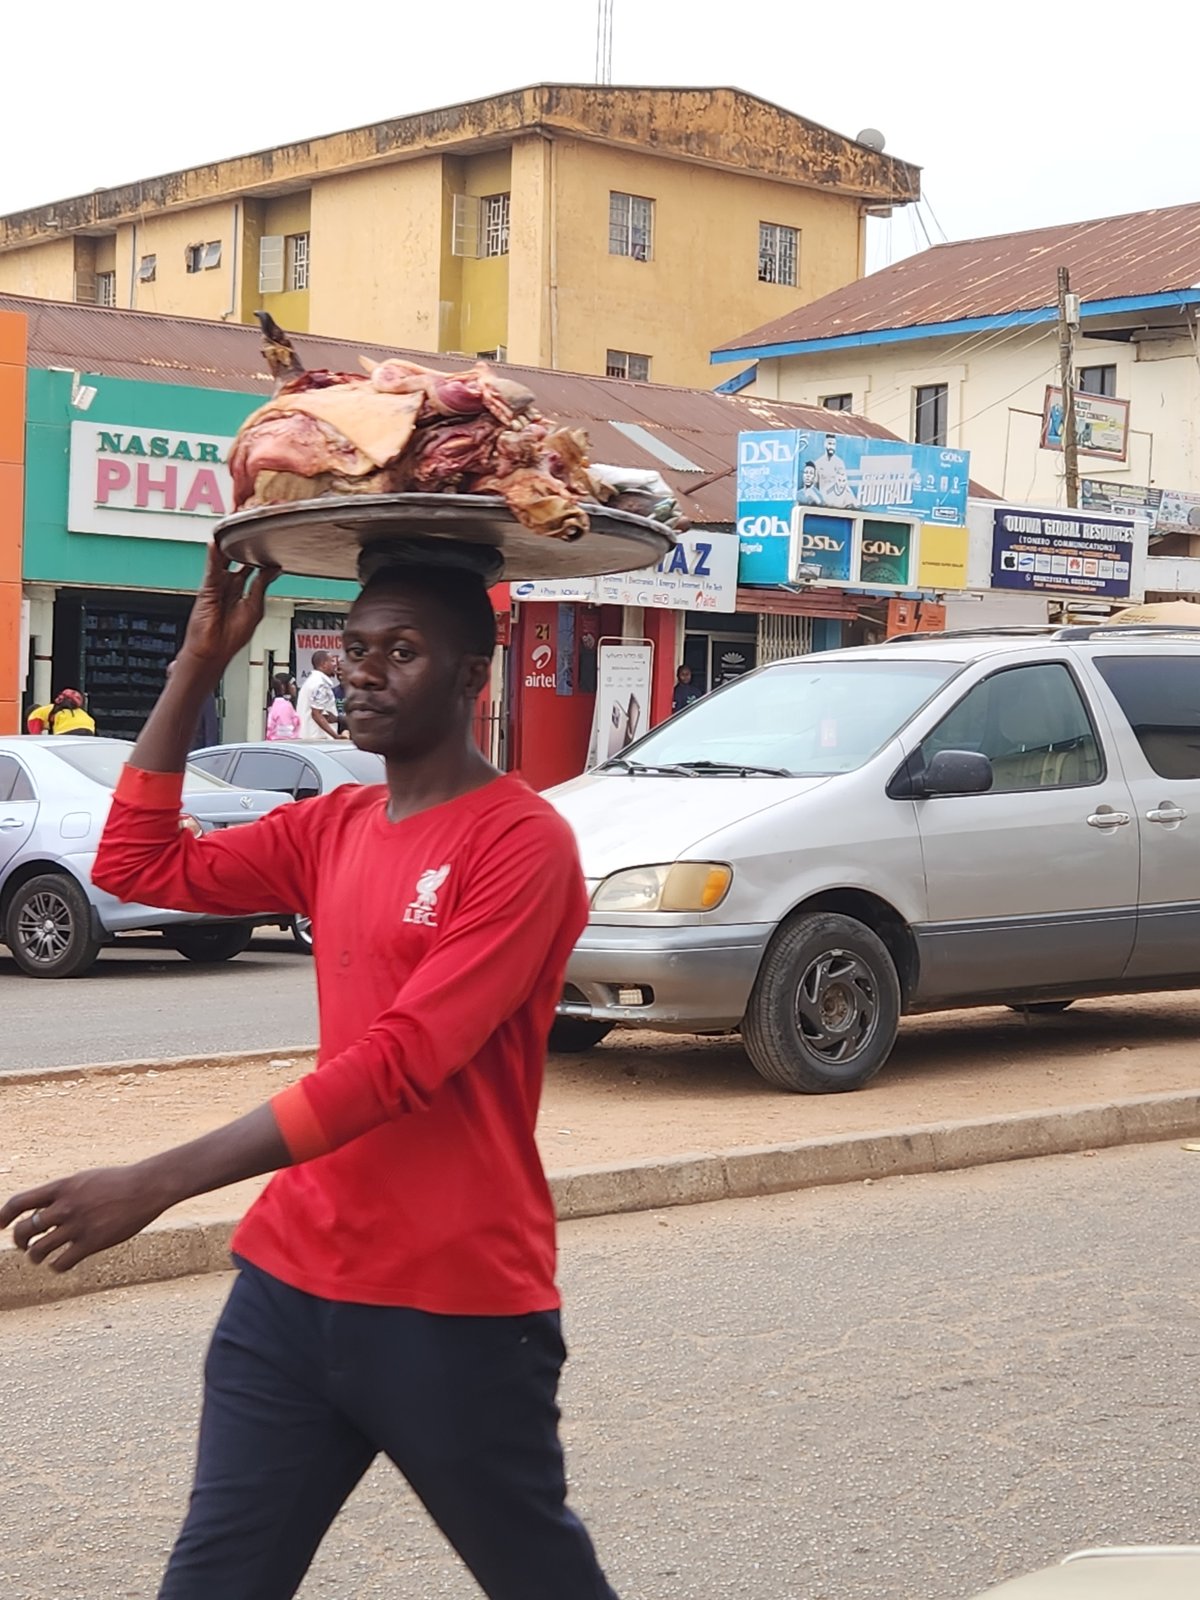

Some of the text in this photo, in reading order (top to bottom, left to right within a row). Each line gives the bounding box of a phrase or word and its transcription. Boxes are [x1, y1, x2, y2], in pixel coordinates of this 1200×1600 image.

[97, 431, 228, 464] NASAR
[657, 542, 712, 576] AZ
[536, 624, 550, 640] 21
[525, 672, 556, 688] airtel
